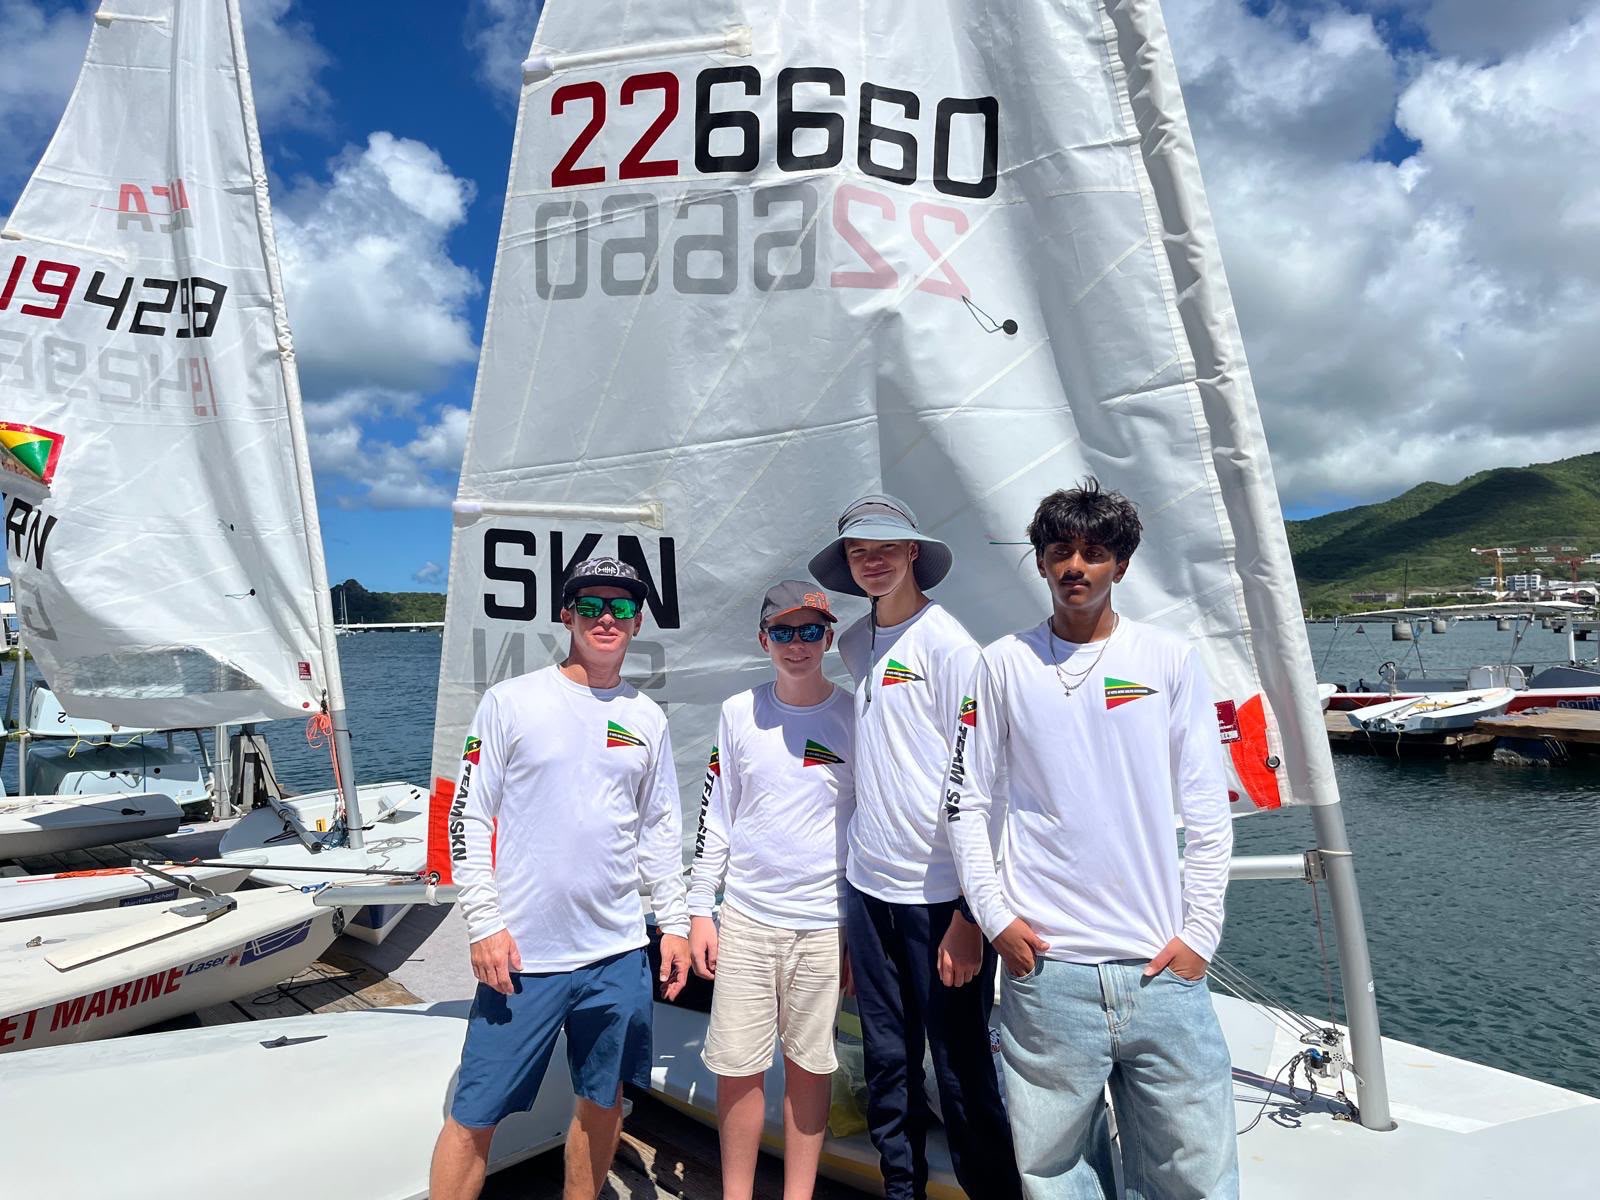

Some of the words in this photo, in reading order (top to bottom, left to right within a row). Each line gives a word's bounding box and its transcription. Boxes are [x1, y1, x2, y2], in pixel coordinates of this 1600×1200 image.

[551, 65, 999, 199] 226660
[2, 492, 58, 571] RN
[483, 528, 681, 629] SKN
[450, 764, 472, 819] TEAM
[450, 820, 467, 861] SKN
[185, 955, 229, 976] Laser
[50, 967, 184, 1032] MARINE
